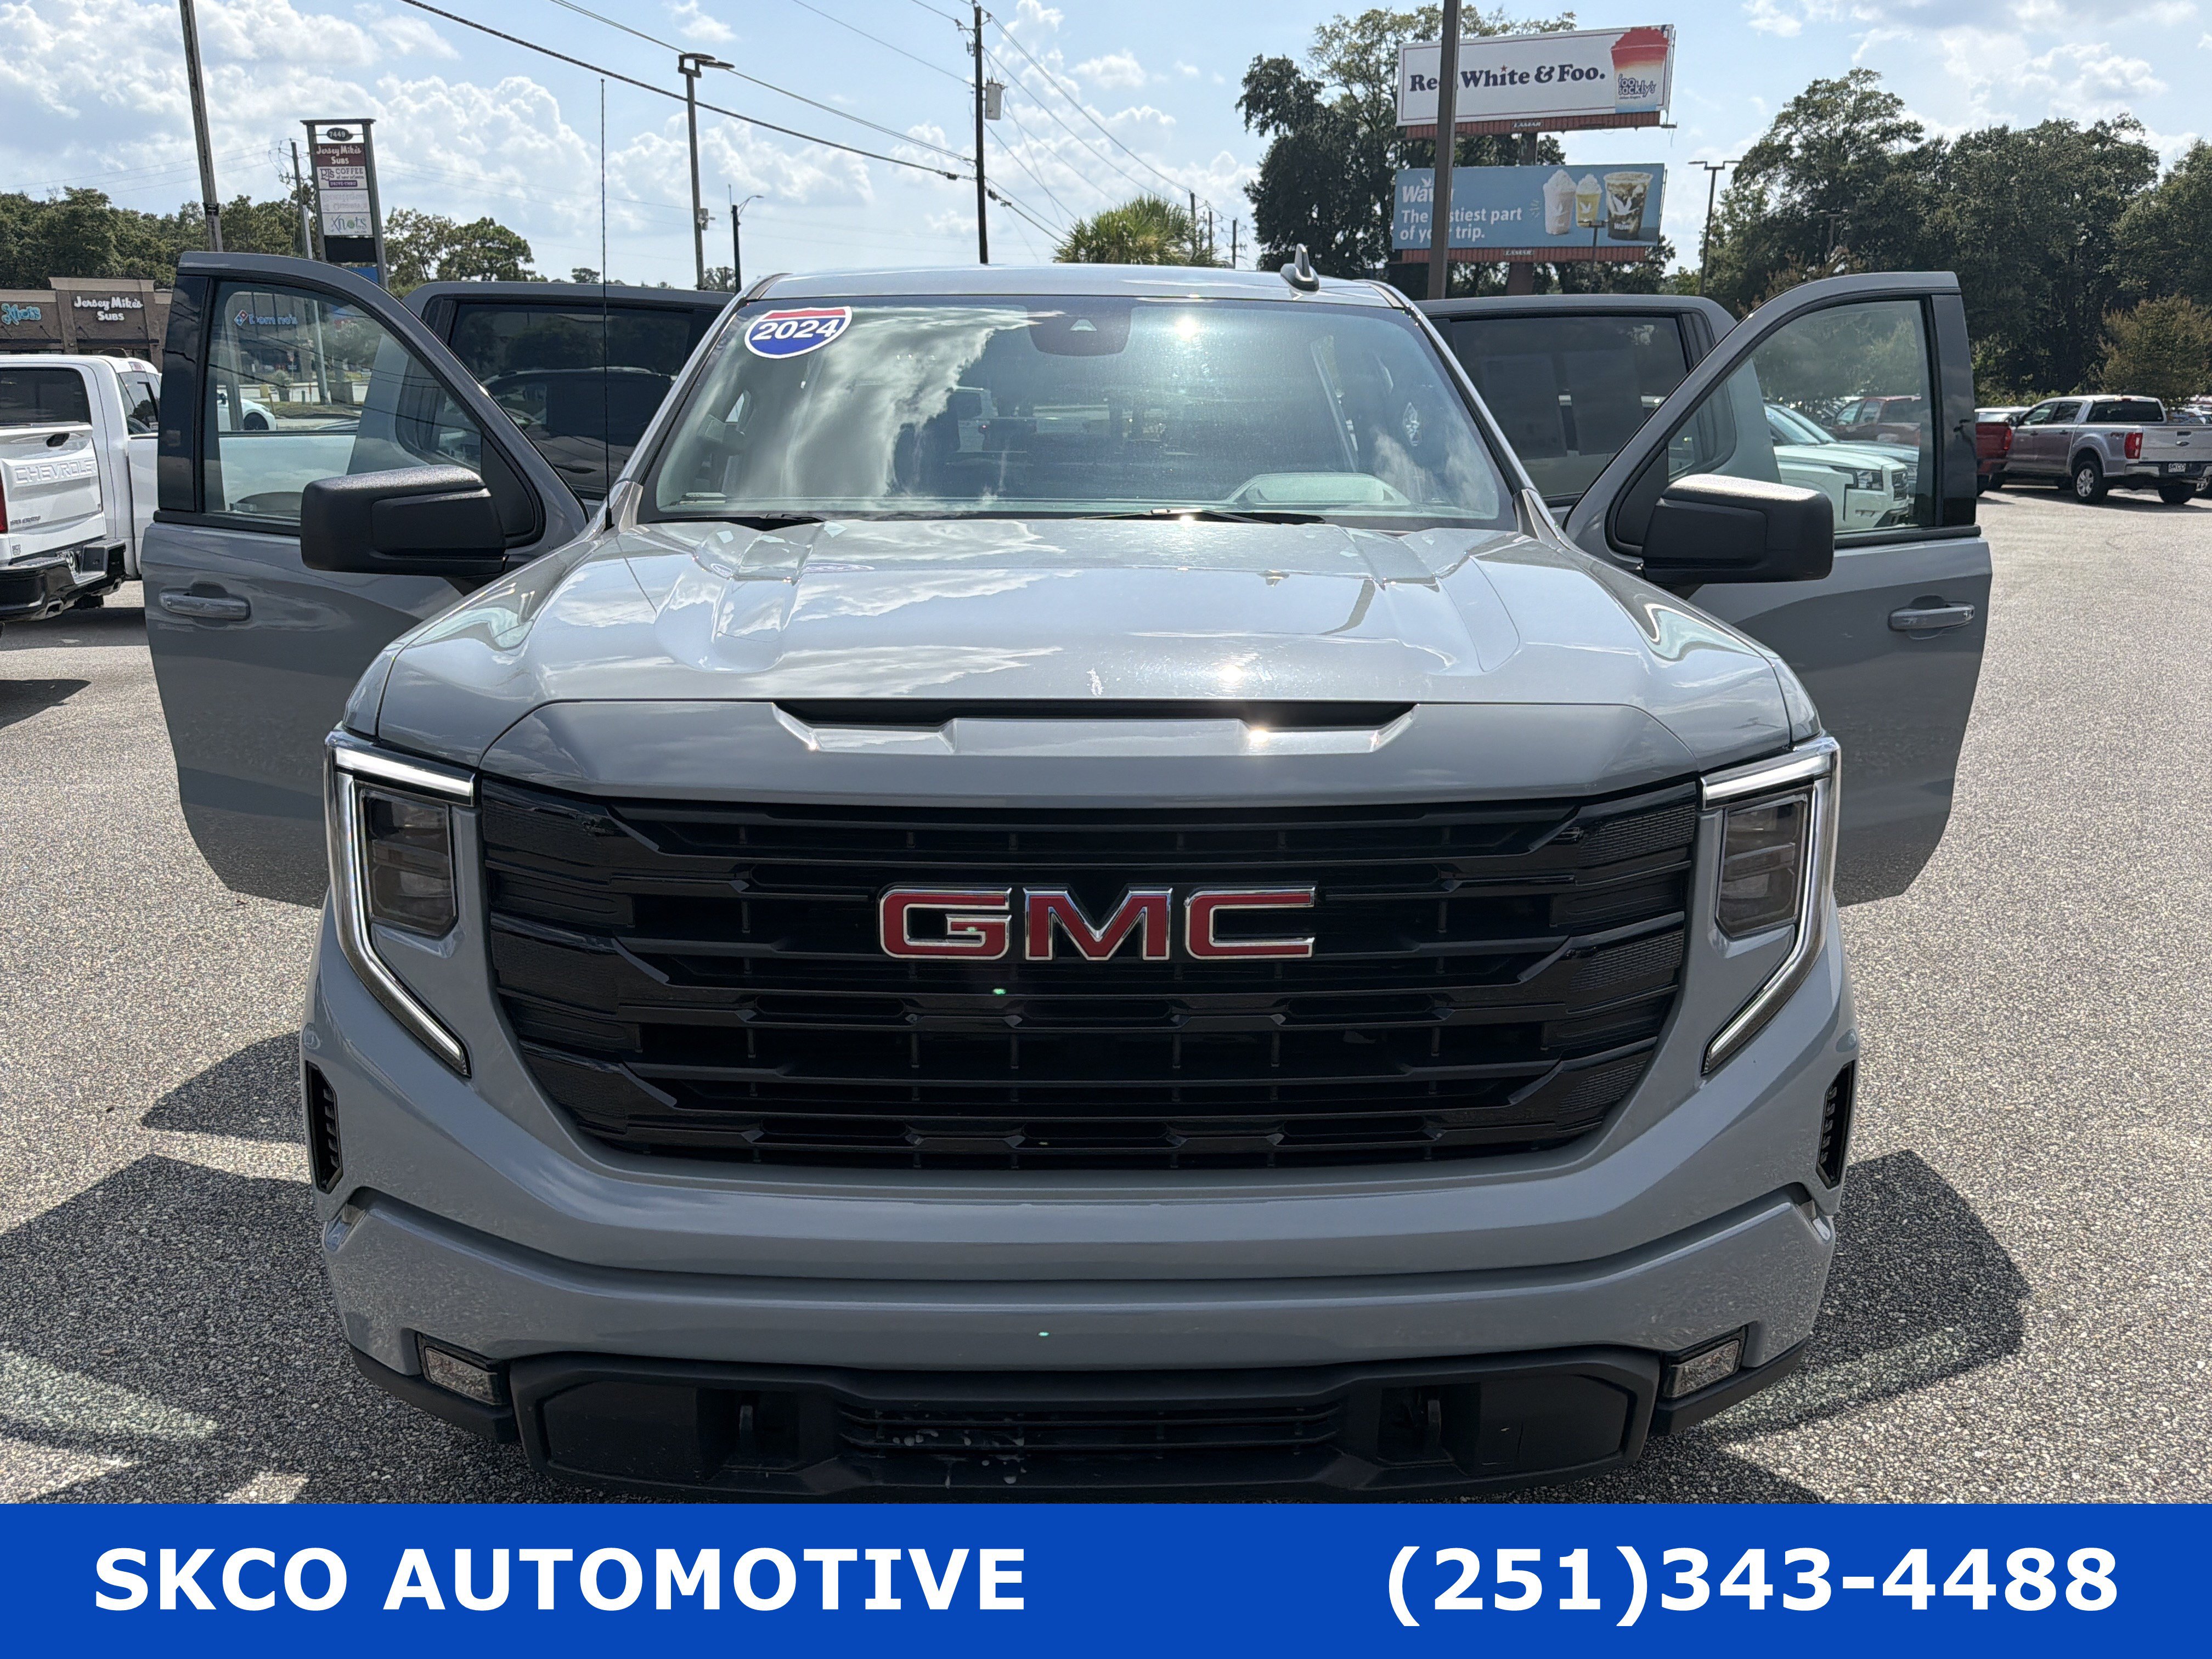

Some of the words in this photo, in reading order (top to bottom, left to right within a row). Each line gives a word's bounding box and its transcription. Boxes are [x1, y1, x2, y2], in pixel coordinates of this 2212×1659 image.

[1410, 74, 1458, 92] Re,
[1461, 65, 1530, 88] White
[1534, 66, 1554, 83] &
[1558, 64, 1605, 82] Foo.
[1618, 74, 1636, 87] foo
[316, 145, 340, 156] Jersey
[341, 145, 362, 154] Mike's
[1401, 209, 1428, 223] The
[1491, 207, 1522, 224] part
[1400, 225, 1415, 240] of
[1455, 224, 1485, 242] trip.
[74, 296, 110, 311] Jersey
[111, 297, 143, 309] Mike's
[752, 319, 840, 341] 2024
[880, 887, 1316, 960] GMC
